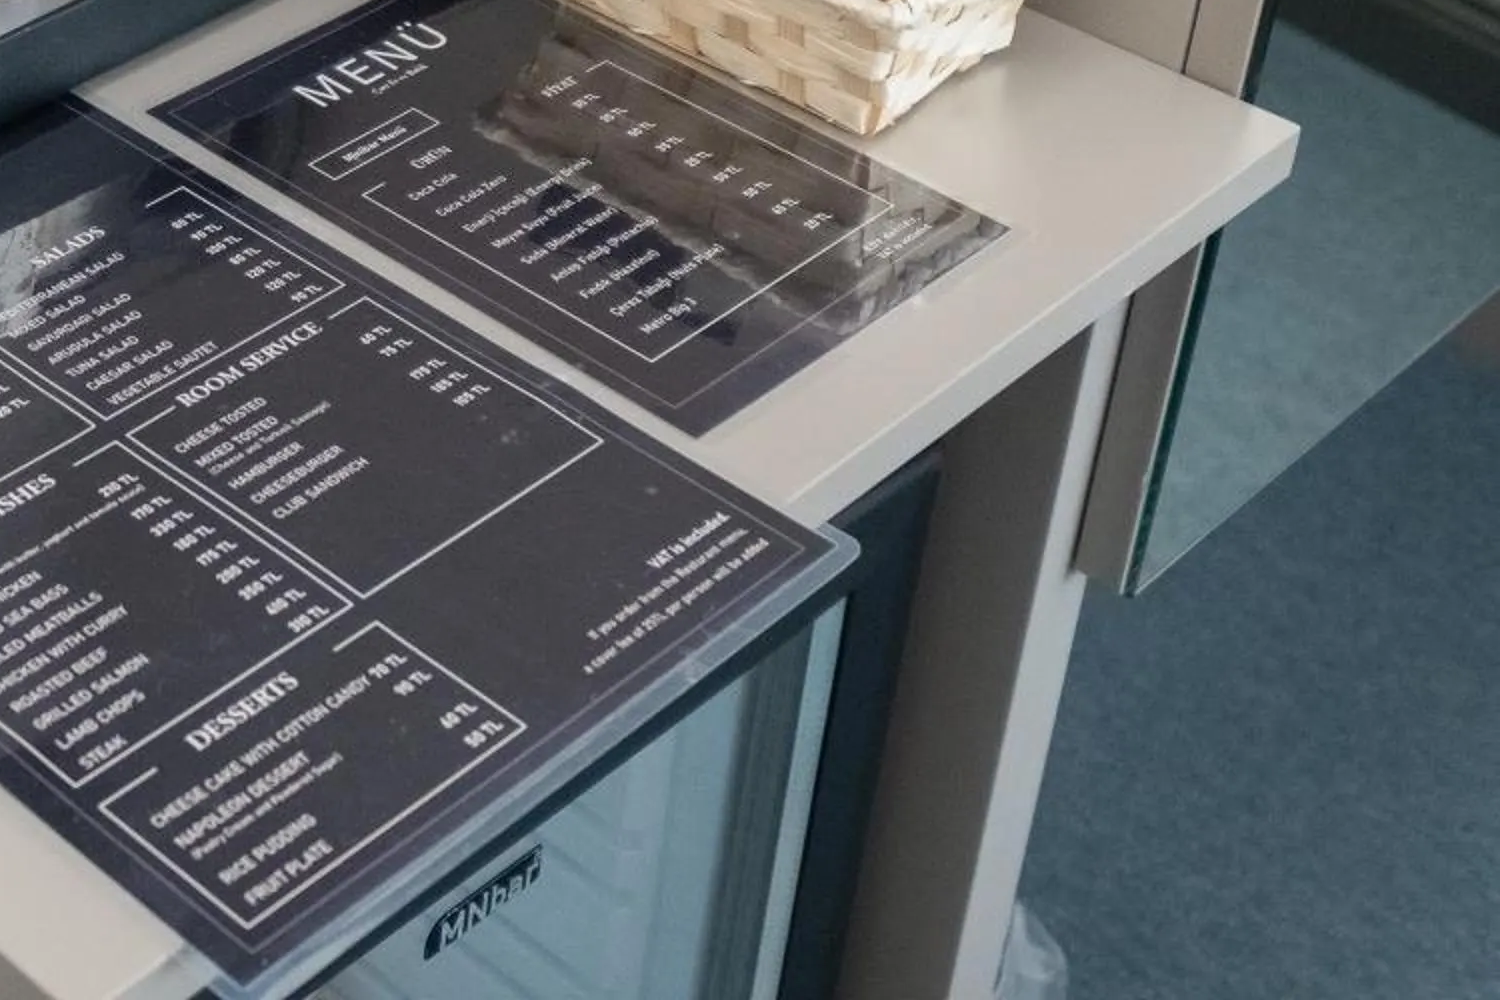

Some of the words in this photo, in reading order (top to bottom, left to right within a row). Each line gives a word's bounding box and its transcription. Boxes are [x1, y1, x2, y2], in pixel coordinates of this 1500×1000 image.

[293, 21, 446, 107] MENÜ
[406, 184, 436, 201] Coca
[430, 172, 458, 187] Cola
[30, 225, 105, 269] SALADS
[83, 251, 125, 276] SALAD
[260, 257, 282, 269] TL
[280, 270, 302, 281] TL
[44, 294, 86, 319] SALAD
[90, 292, 132, 317] SALAD
[370, 324, 392, 336] TL
[47, 331, 104, 365] ARUGULA
[100, 309, 142, 335] SALAD
[64, 356, 101, 377] TUNA
[97, 334, 139, 360] SALAD
[85, 360, 135, 391] CAESAR
[131, 339, 174, 365] SALAD
[105, 364, 176, 405] VEGETABLE
[175, 365, 244, 407] ROOM
[239, 321, 322, 371] SERVICE
[7, 396, 30, 409] TL
[173, 421, 223, 453] CHEESE
[218, 396, 267, 425] TOSTED
[193, 440, 235, 467] MIXED
[230, 414, 278, 444] TOSTED
[227, 441, 303, 489] HAMBURGER
[249, 444, 343, 504] CHEESEBURGER
[271, 494, 308, 519] CLUB
[303, 456, 369, 499] SANDWICH
[645, 548, 673, 568] VAT
[667, 542, 686, 555] is
[678, 511, 730, 547] included.
[1, 604, 34, 626] SEA
[28, 583, 69, 610] BASS
[23, 591, 103, 642] MEATBALLS
[46, 631, 86, 658] WITH
[81, 604, 127, 637] CURRY
[9, 669, 74, 713] ROASTED
[69, 646, 107, 675] BEEF
[32, 688, 93, 730] GRILLED
[89, 652, 149, 694] SALMON
[54, 717, 99, 750] LAMB
[95, 688, 145, 724] CHOPS
[184, 671, 298, 750] DESSERTS
[452, 701, 478, 717] TL
[78, 734, 127, 769] STEAK
[149, 785, 208, 828] CHEESE
[203, 759, 245, 791] CAKE
[239, 737, 280, 766] WITH
[275, 703, 330, 743] COTTON
[324, 674, 371, 709] CANDY
[173, 792, 252, 848] NAPOLEON
[246, 750, 309, 798] DESSERT
[217, 854, 257, 885] RICE
[251, 813, 317, 861] PUDDING
[243, 868, 288, 905] FRUIT
[283, 838, 333, 876] PLATE
